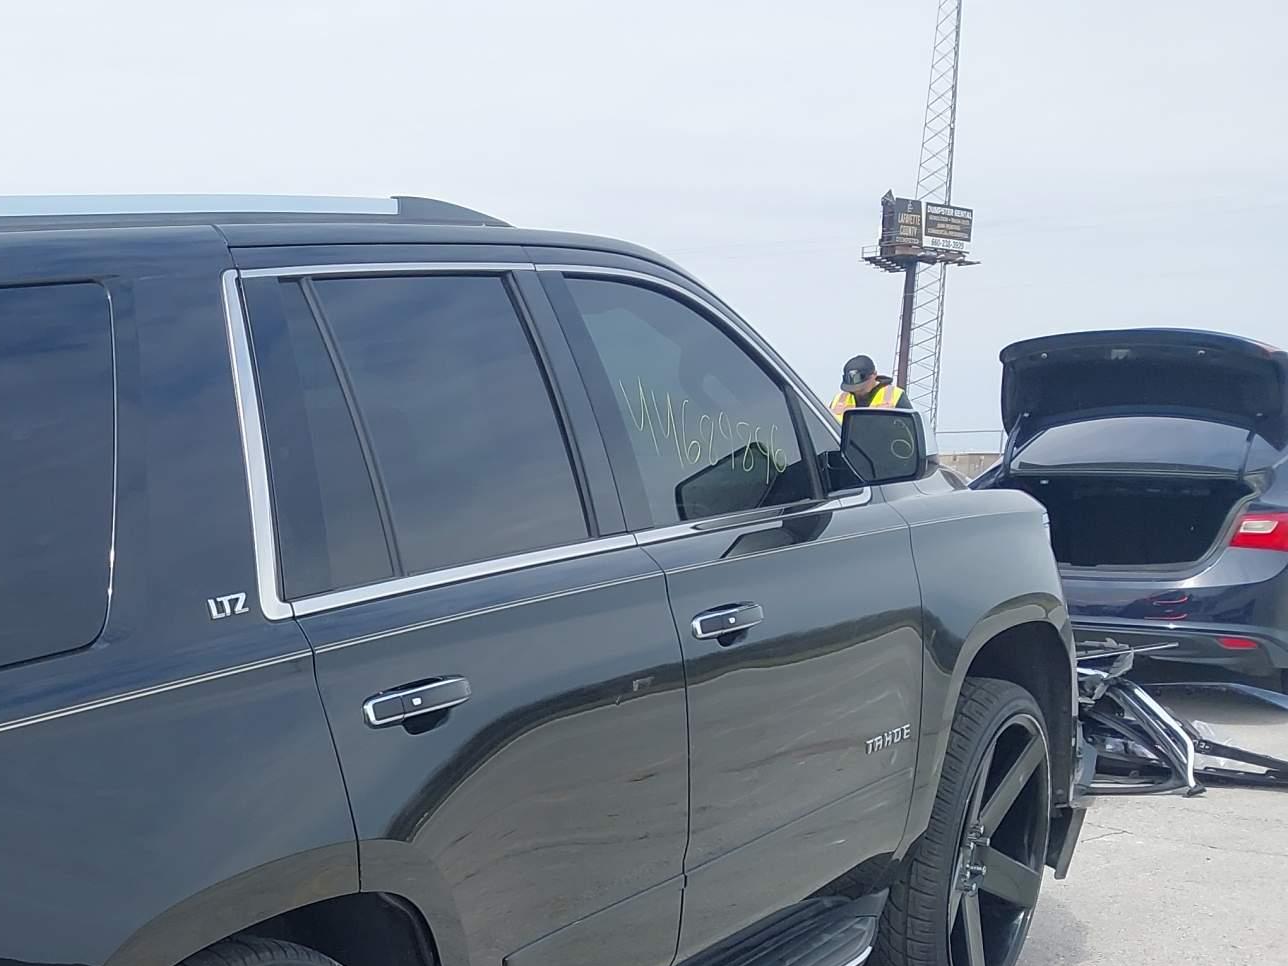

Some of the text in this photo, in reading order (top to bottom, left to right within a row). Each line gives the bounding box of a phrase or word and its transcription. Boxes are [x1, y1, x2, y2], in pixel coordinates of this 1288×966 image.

[898, 212, 921, 225] LAFAYETTE
[900, 225, 918, 237] COUNTY
[207, 592, 249, 619] LTZ
[865, 723, 911, 755] TAHOE
